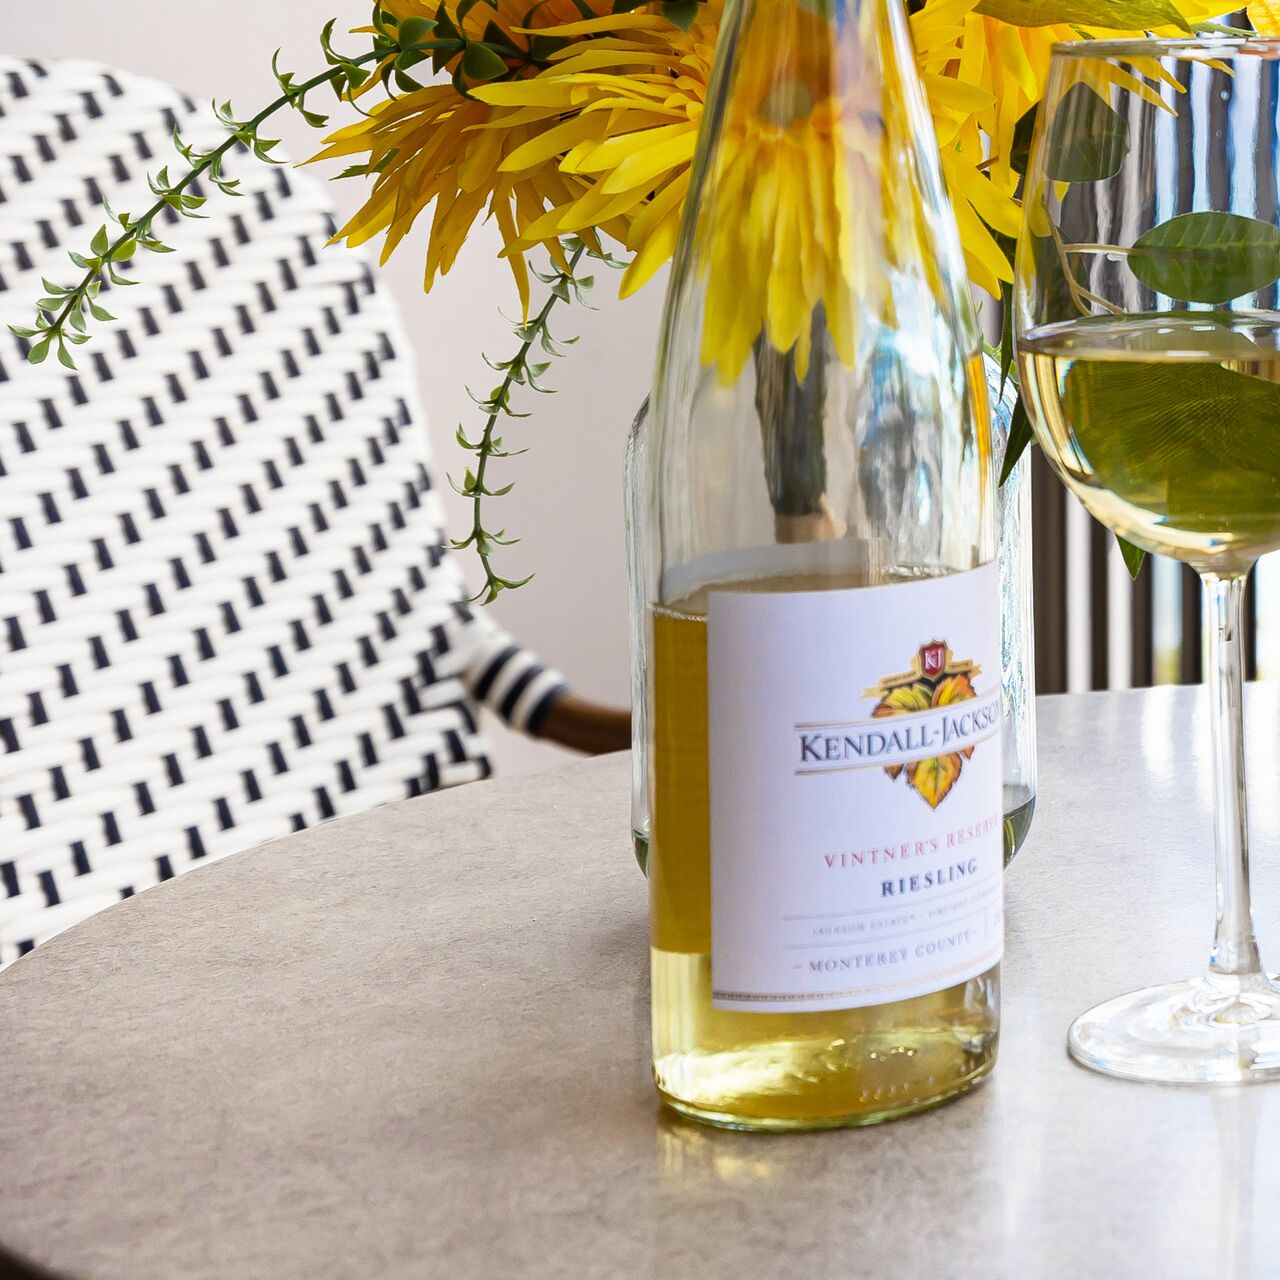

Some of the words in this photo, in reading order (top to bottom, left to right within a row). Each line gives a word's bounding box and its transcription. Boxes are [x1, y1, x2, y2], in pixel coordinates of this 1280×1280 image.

[824, 838, 939, 869] VINTNER'S
[881, 858, 977, 898] RIESLING
[808, 948, 908, 972] MONTEREY
[914, 930, 970, 958] COUNTY
